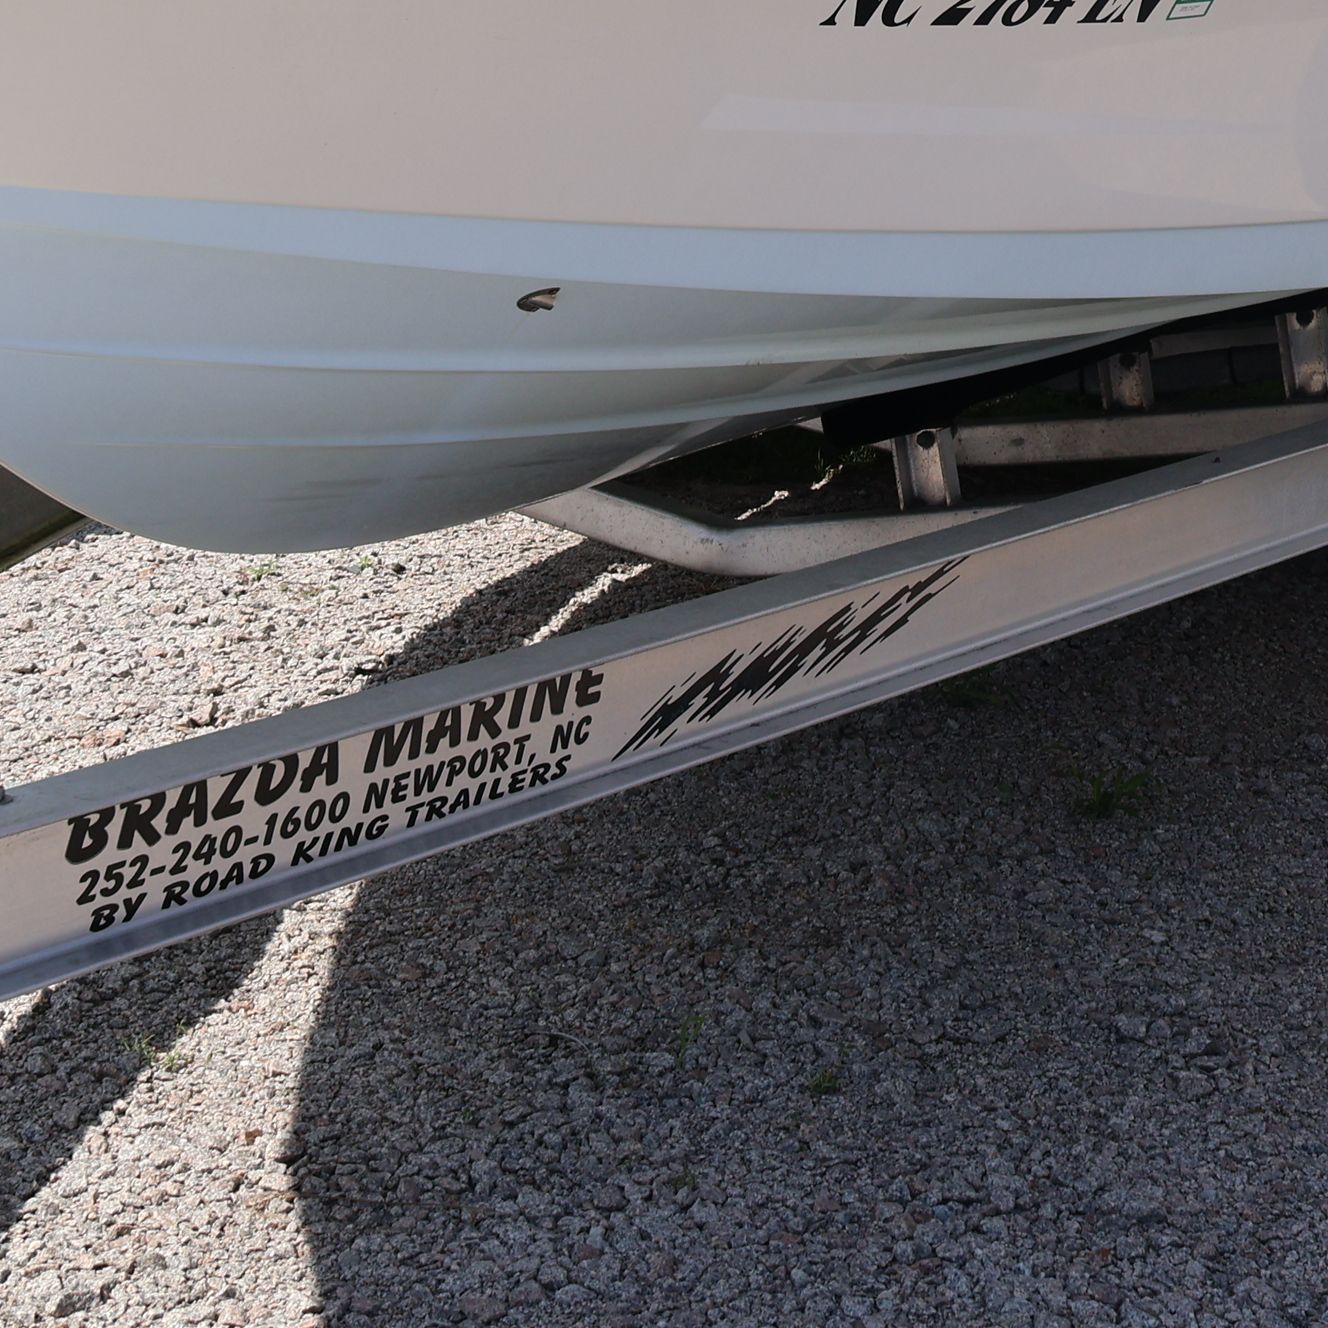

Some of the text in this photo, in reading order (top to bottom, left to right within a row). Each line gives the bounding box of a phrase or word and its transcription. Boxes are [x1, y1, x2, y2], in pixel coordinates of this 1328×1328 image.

[76, 714, 593, 906] 252-240-1600 NEWPORT, NC
[363, 668, 605, 773] MARINE
[88, 753, 572, 933] BY ROAD KING TRAILERS
